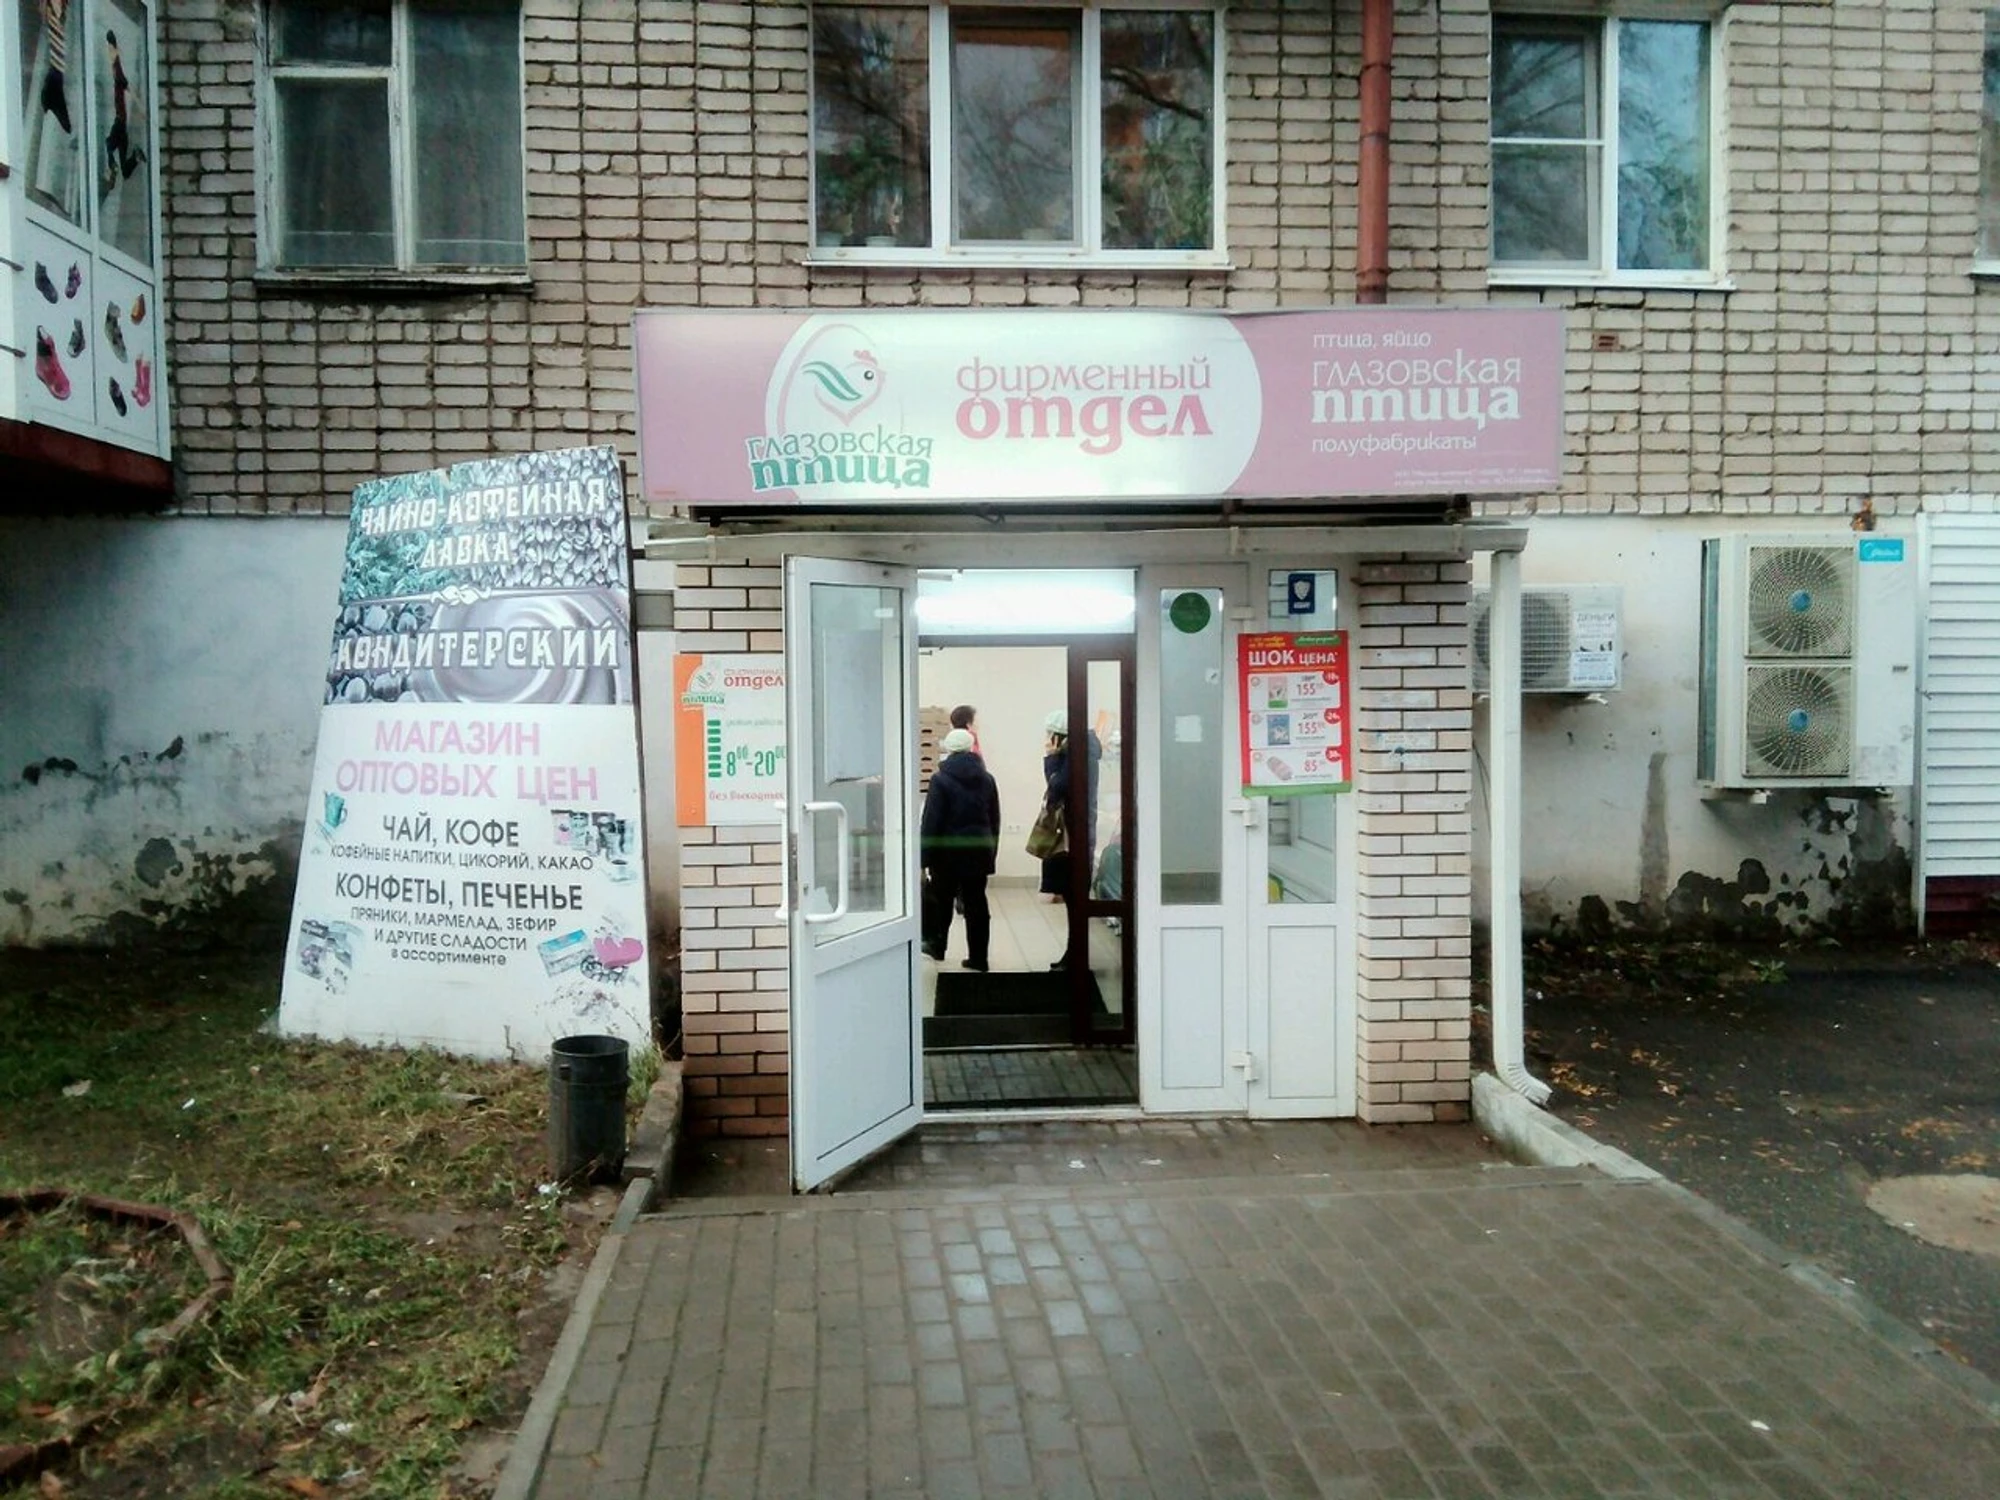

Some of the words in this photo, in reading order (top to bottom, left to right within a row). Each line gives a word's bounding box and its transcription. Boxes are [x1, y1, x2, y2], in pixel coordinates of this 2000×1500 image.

[1312, 332, 1377, 349] птица,
[1382, 329, 1432, 348] яйцо
[955, 355, 1212, 399] фирменный
[954, 394, 1213, 456] отдел
[1311, 385, 1522, 430] птица
[1312, 431, 1477, 457] полуфабрикаты
[751, 454, 930, 490] птица
[360, 477, 606, 536] ЧАЙНО-КОФЕЙНАЯ
[421, 531, 513, 568] ЛАВКА
[334, 620, 619, 675] КОНДИТЕРСКИЙ
[1248, 649, 1296, 666] ШОК
[723, 675, 784, 690] отдел
[374, 719, 541, 756] МАГАЗИН
[335, 760, 498, 798] ОПТОВЫХ
[516, 765, 600, 805] ЦЕН
[382, 811, 438, 848] ЧАЙ,
[445, 818, 519, 848] КОФЕ
[330, 843, 390, 862] КОФЕЙНЫЕ
[393, 848, 455, 867] НАПИТКИ,
[458, 851, 534, 870] ЦИКОРИЙ,
[537, 855, 594, 871] КАКАО
[335, 872, 454, 909] КОНФЕТЫ,
[461, 881, 584, 911] ПЕЧЕНЬЕ
[350, 906, 411, 927] ПРЯНИКИ,
[414, 912, 503, 932] МАРМЕЛАД,
[507, 915, 557, 932] ЗЕФИР
[374, 928, 384, 942] И
[386, 929, 438, 947] ДРУГИЕ
[440, 934, 528, 952] СЛАДОСТИ
[401, 951, 507, 966] ассортименте
